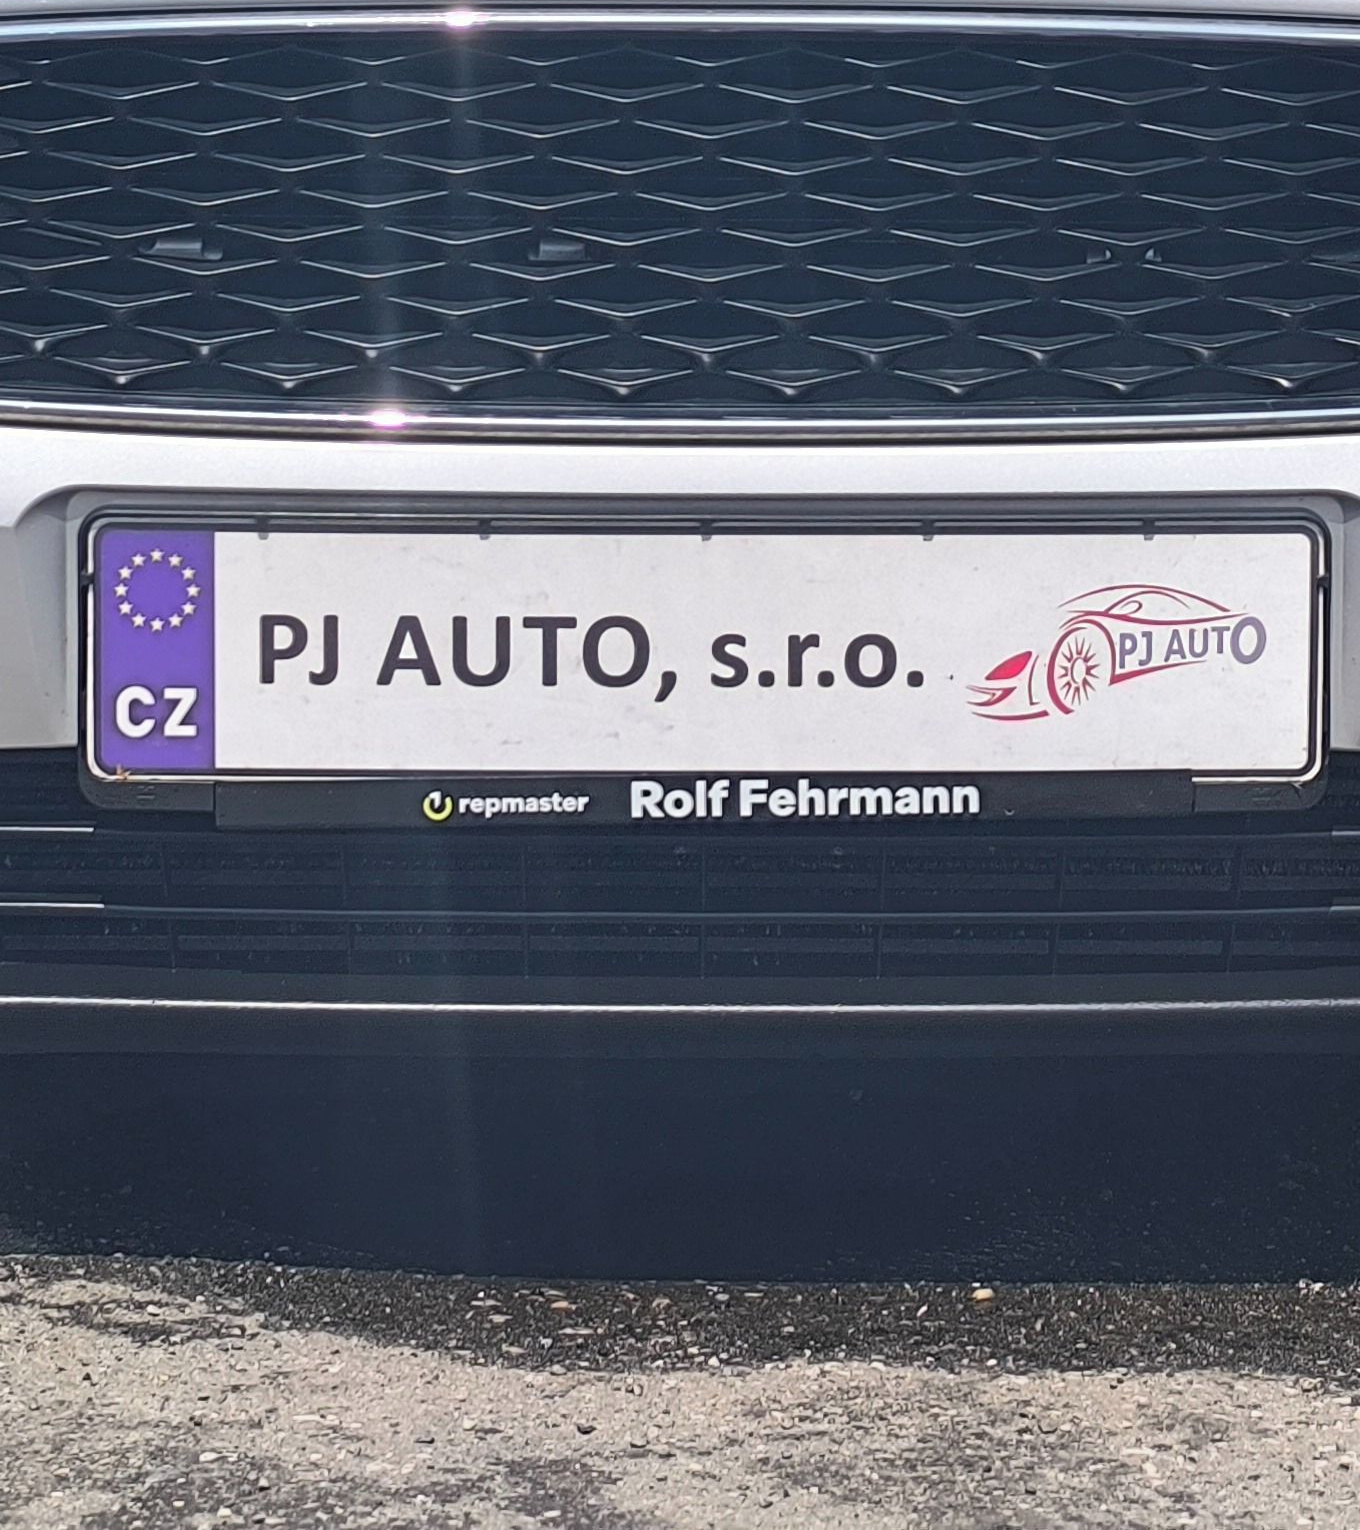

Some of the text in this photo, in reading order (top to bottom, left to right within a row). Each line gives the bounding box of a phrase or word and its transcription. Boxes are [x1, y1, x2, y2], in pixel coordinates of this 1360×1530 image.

[259, 614, 924, 702] PJ AUTO, s.r.o.
[1118, 617, 1267, 669] PJ AUTO
[115, 686, 199, 738] CZ
[458, 792, 590, 816] repmaster
[631, 779, 981, 819] Rolf Fehrmann
